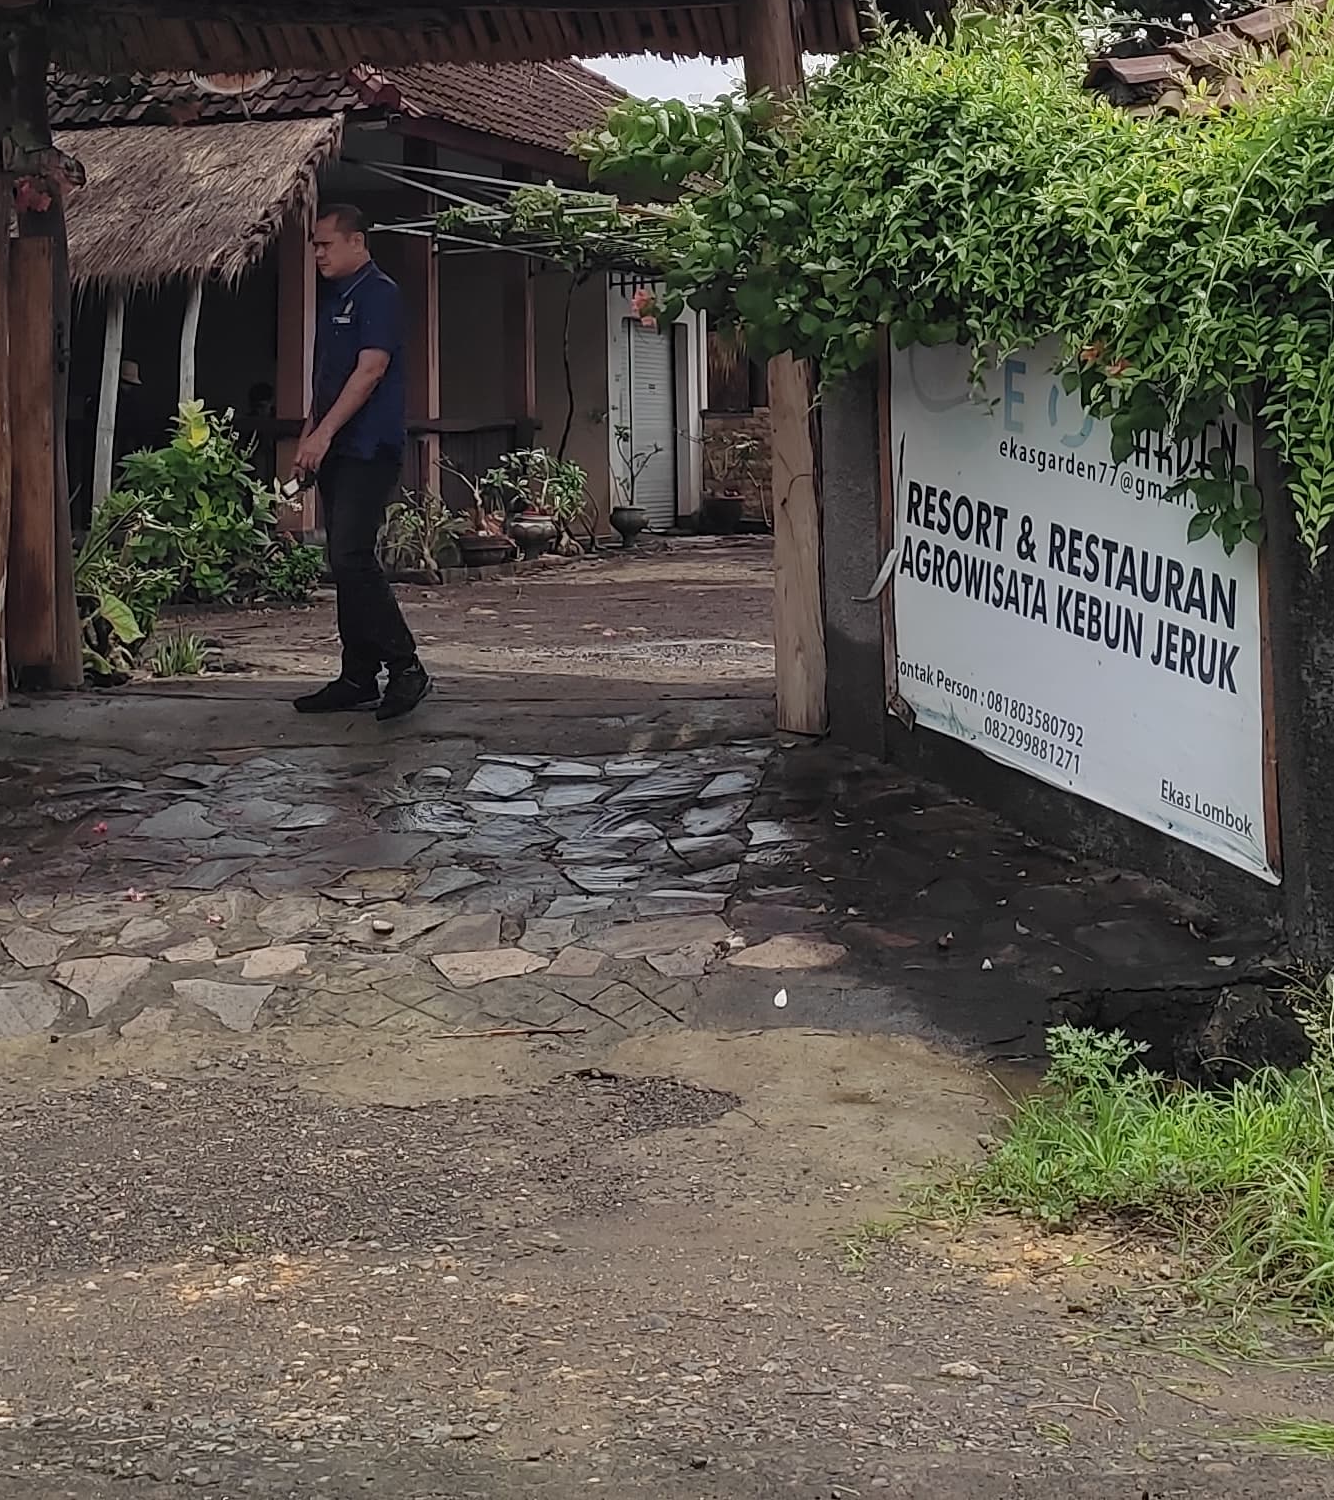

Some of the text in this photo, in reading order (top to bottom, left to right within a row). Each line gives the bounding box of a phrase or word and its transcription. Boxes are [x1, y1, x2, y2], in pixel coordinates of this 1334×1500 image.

[905, 480, 1238, 631] RESORT & RESTAURAN
[899, 534, 1241, 695] AGROWISATA KEBUN JERUK
[936, 669, 978, 704] Person
[987, 689, 1084, 748] 081803580792
[984, 716, 1081, 775] 082299881271
[1160, 778, 1254, 838] Ekas Lombok
